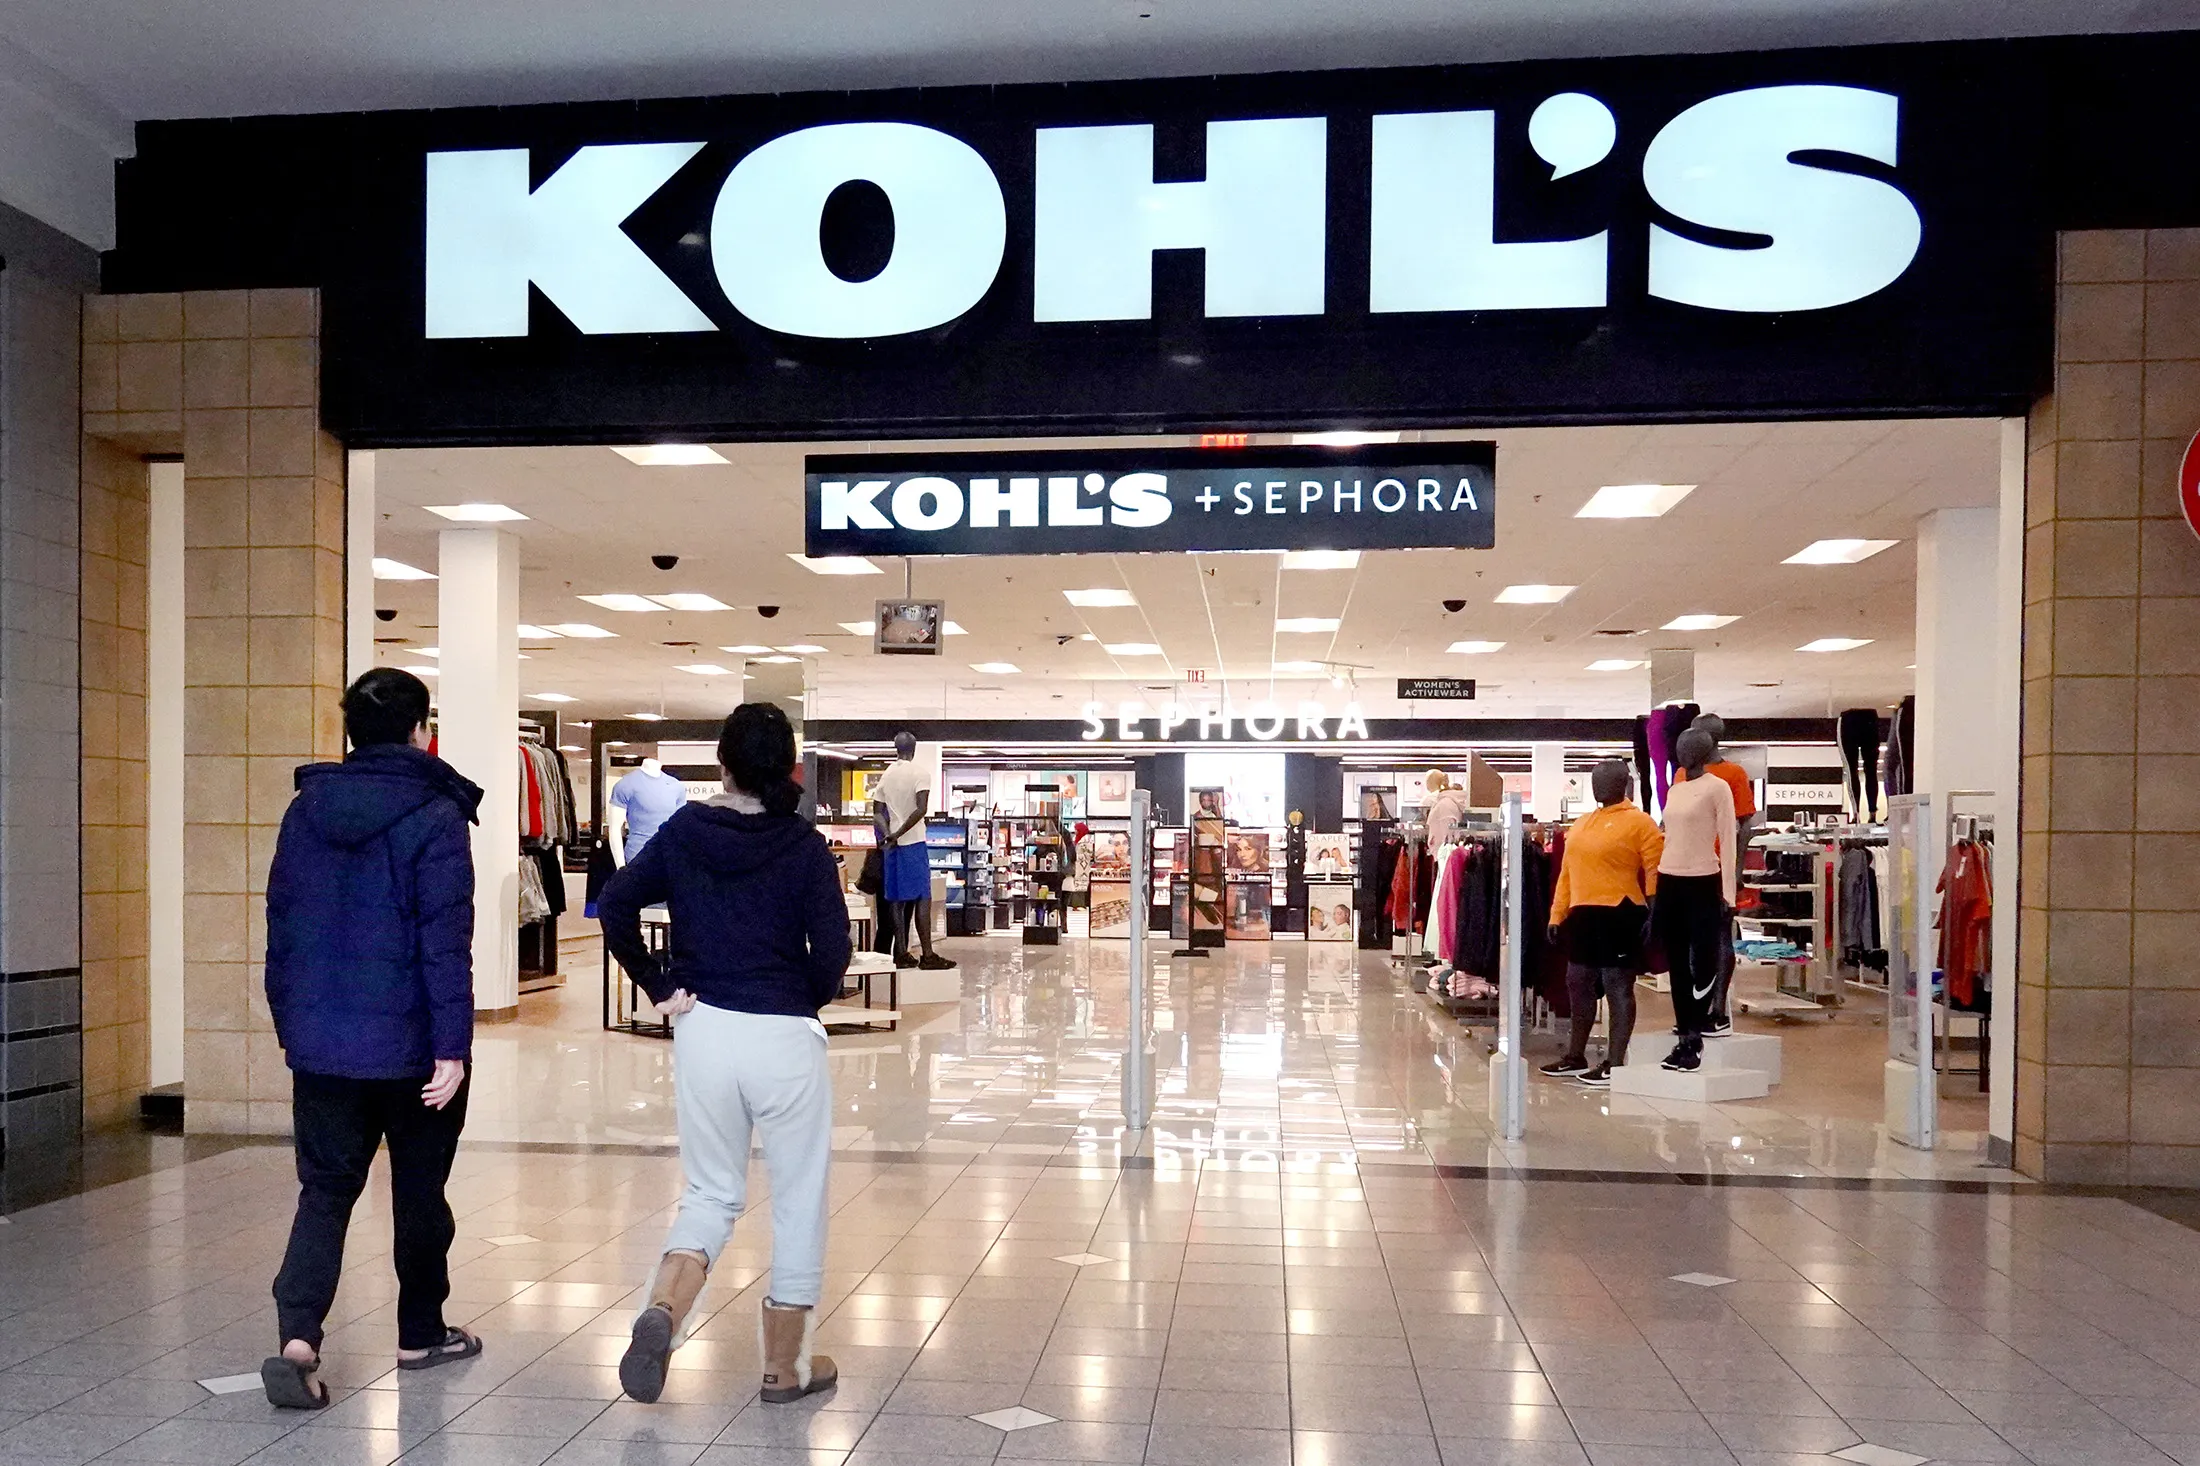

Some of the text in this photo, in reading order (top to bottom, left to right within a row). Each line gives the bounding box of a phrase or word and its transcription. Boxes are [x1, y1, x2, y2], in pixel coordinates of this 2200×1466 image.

[425, 84, 1922, 339] KOHL'S
[820, 472, 1173, 532] KOHL'S
[1413, 681, 1460, 689] WOMEN'S
[1404, 689, 1469, 697] ACTIVEWEAR
[1081, 701, 1369, 740] SEPHORA
[685, 786, 716, 795] HORA
[1775, 790, 1834, 799] SEPHORA
